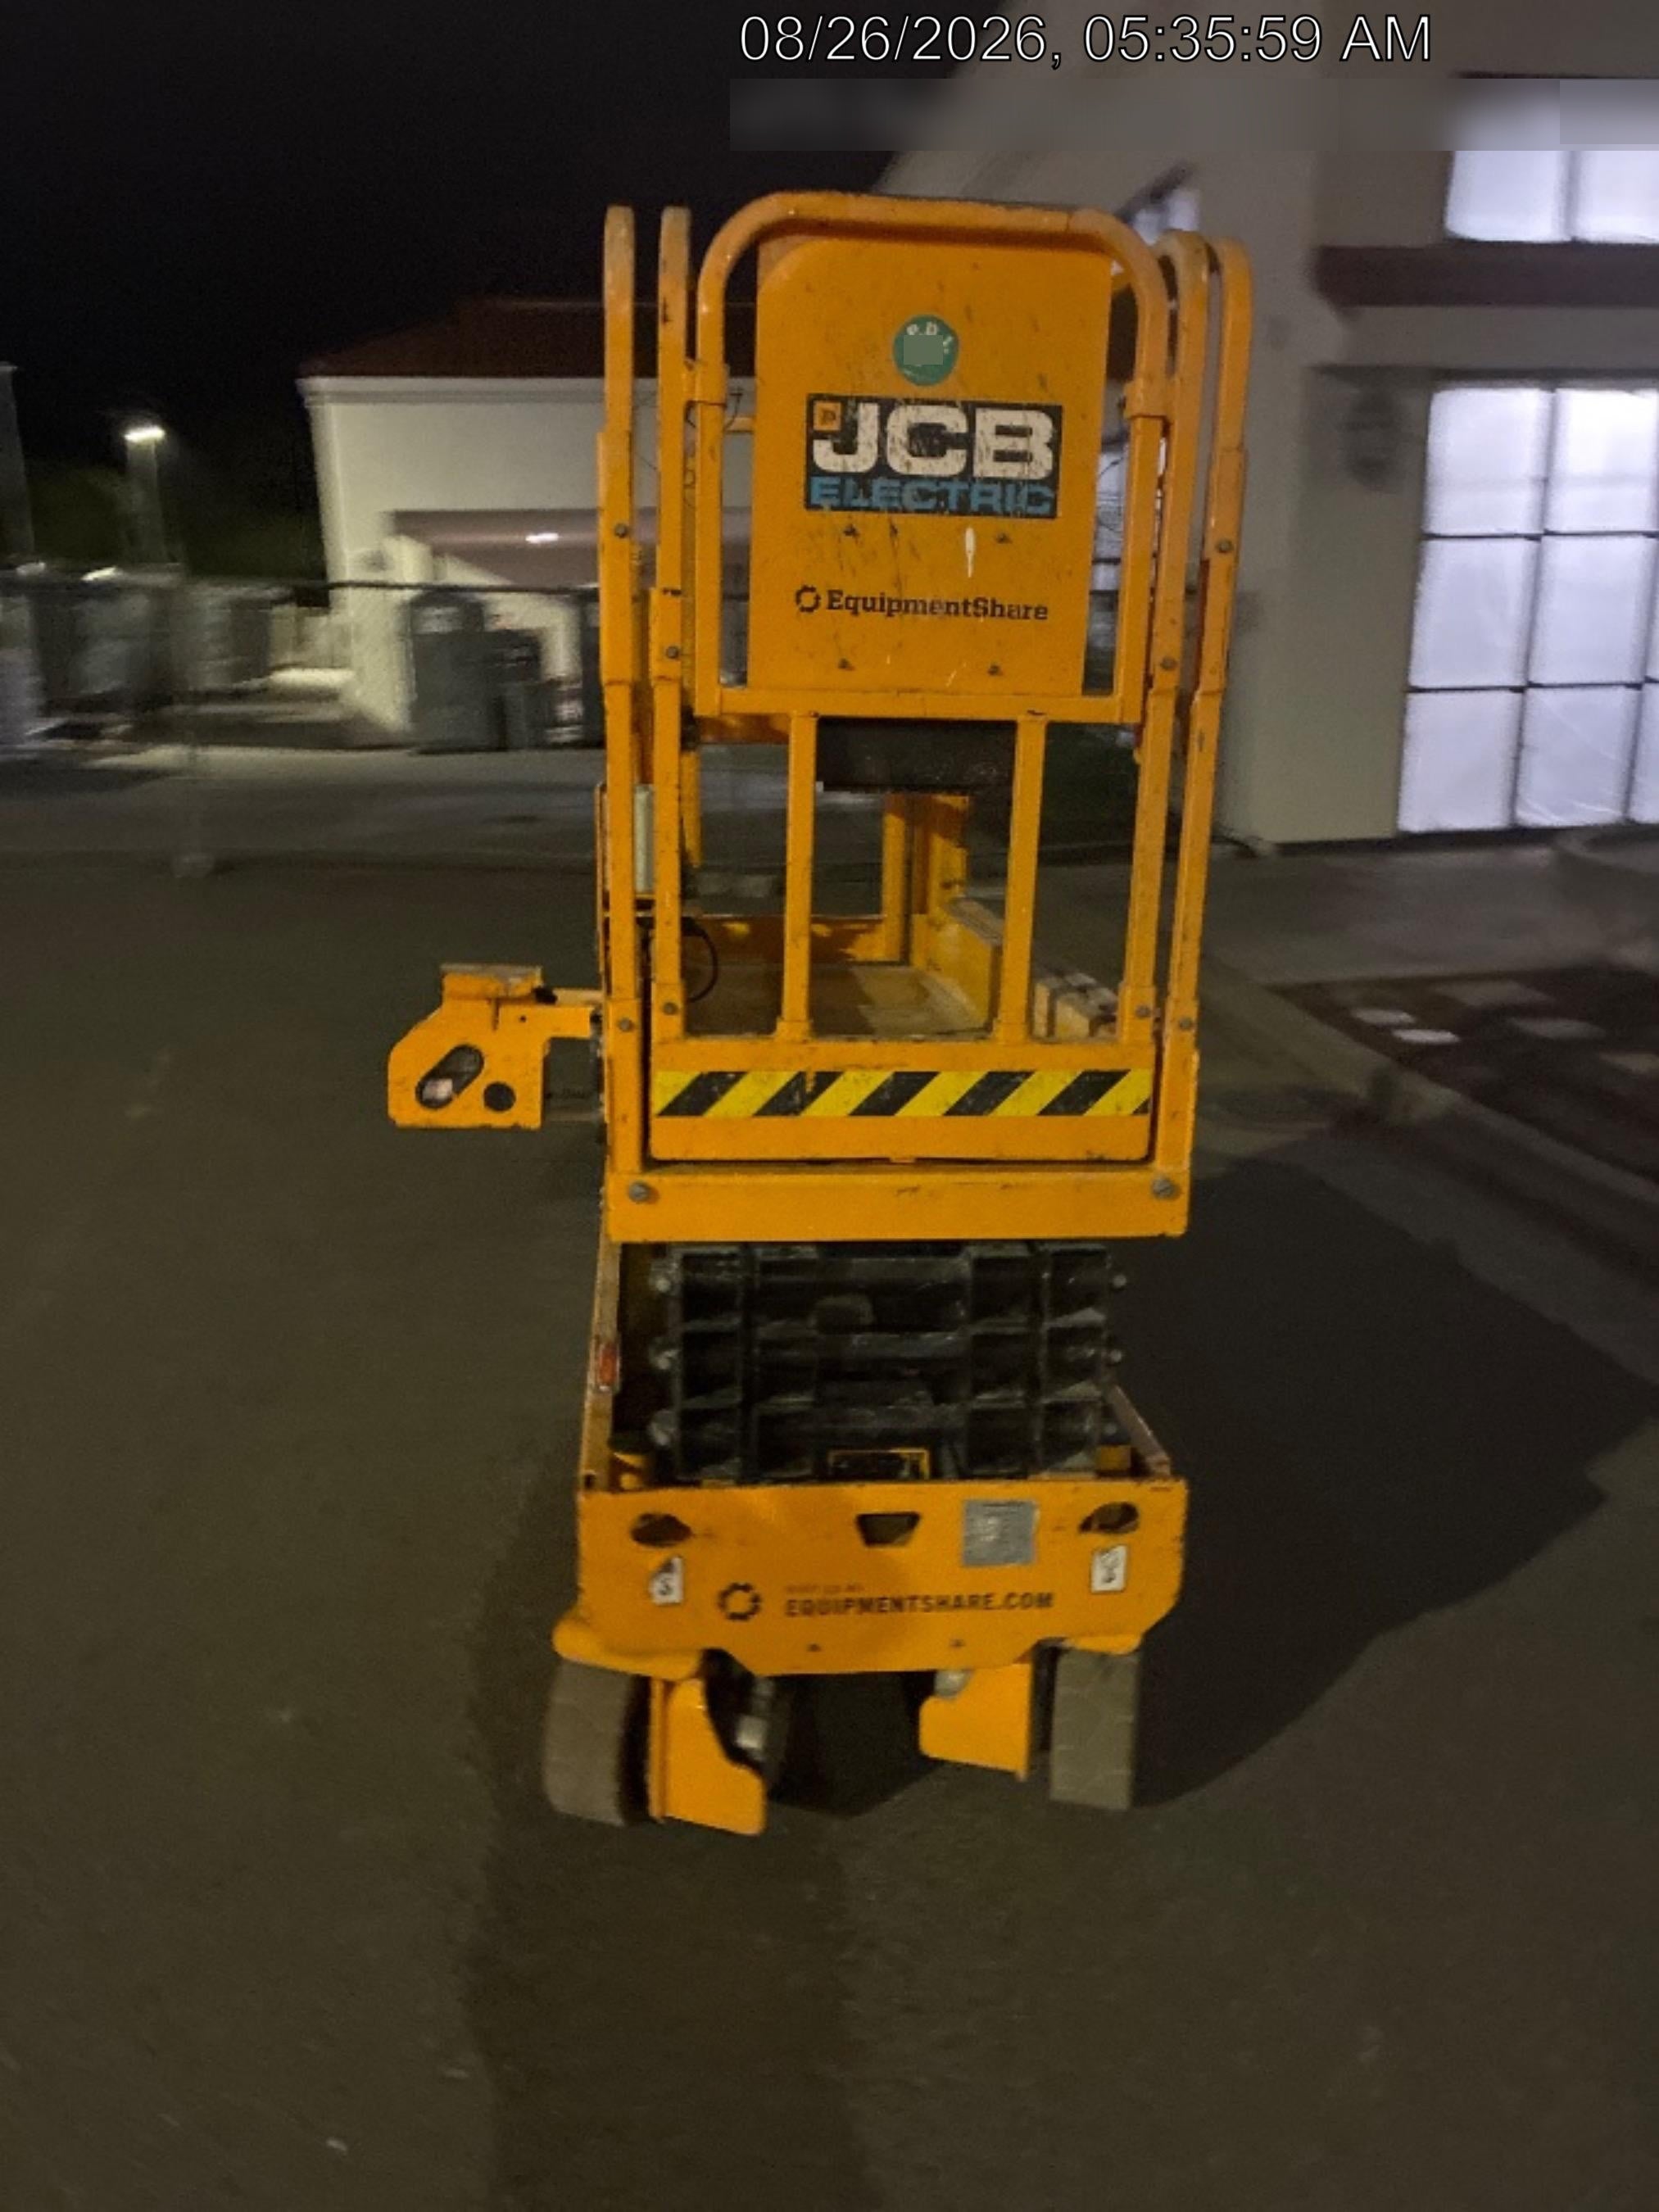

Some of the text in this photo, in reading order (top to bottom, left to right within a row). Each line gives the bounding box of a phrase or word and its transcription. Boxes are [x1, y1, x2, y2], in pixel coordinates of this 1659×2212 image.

[813, 402, 1054, 479] JCB
[810, 476, 1054, 514] ELECTRIC
[826, 589, 1049, 620] EquipmentShare
[785, 1592, 1054, 1617] EQUIPMENTSHARE.COM
